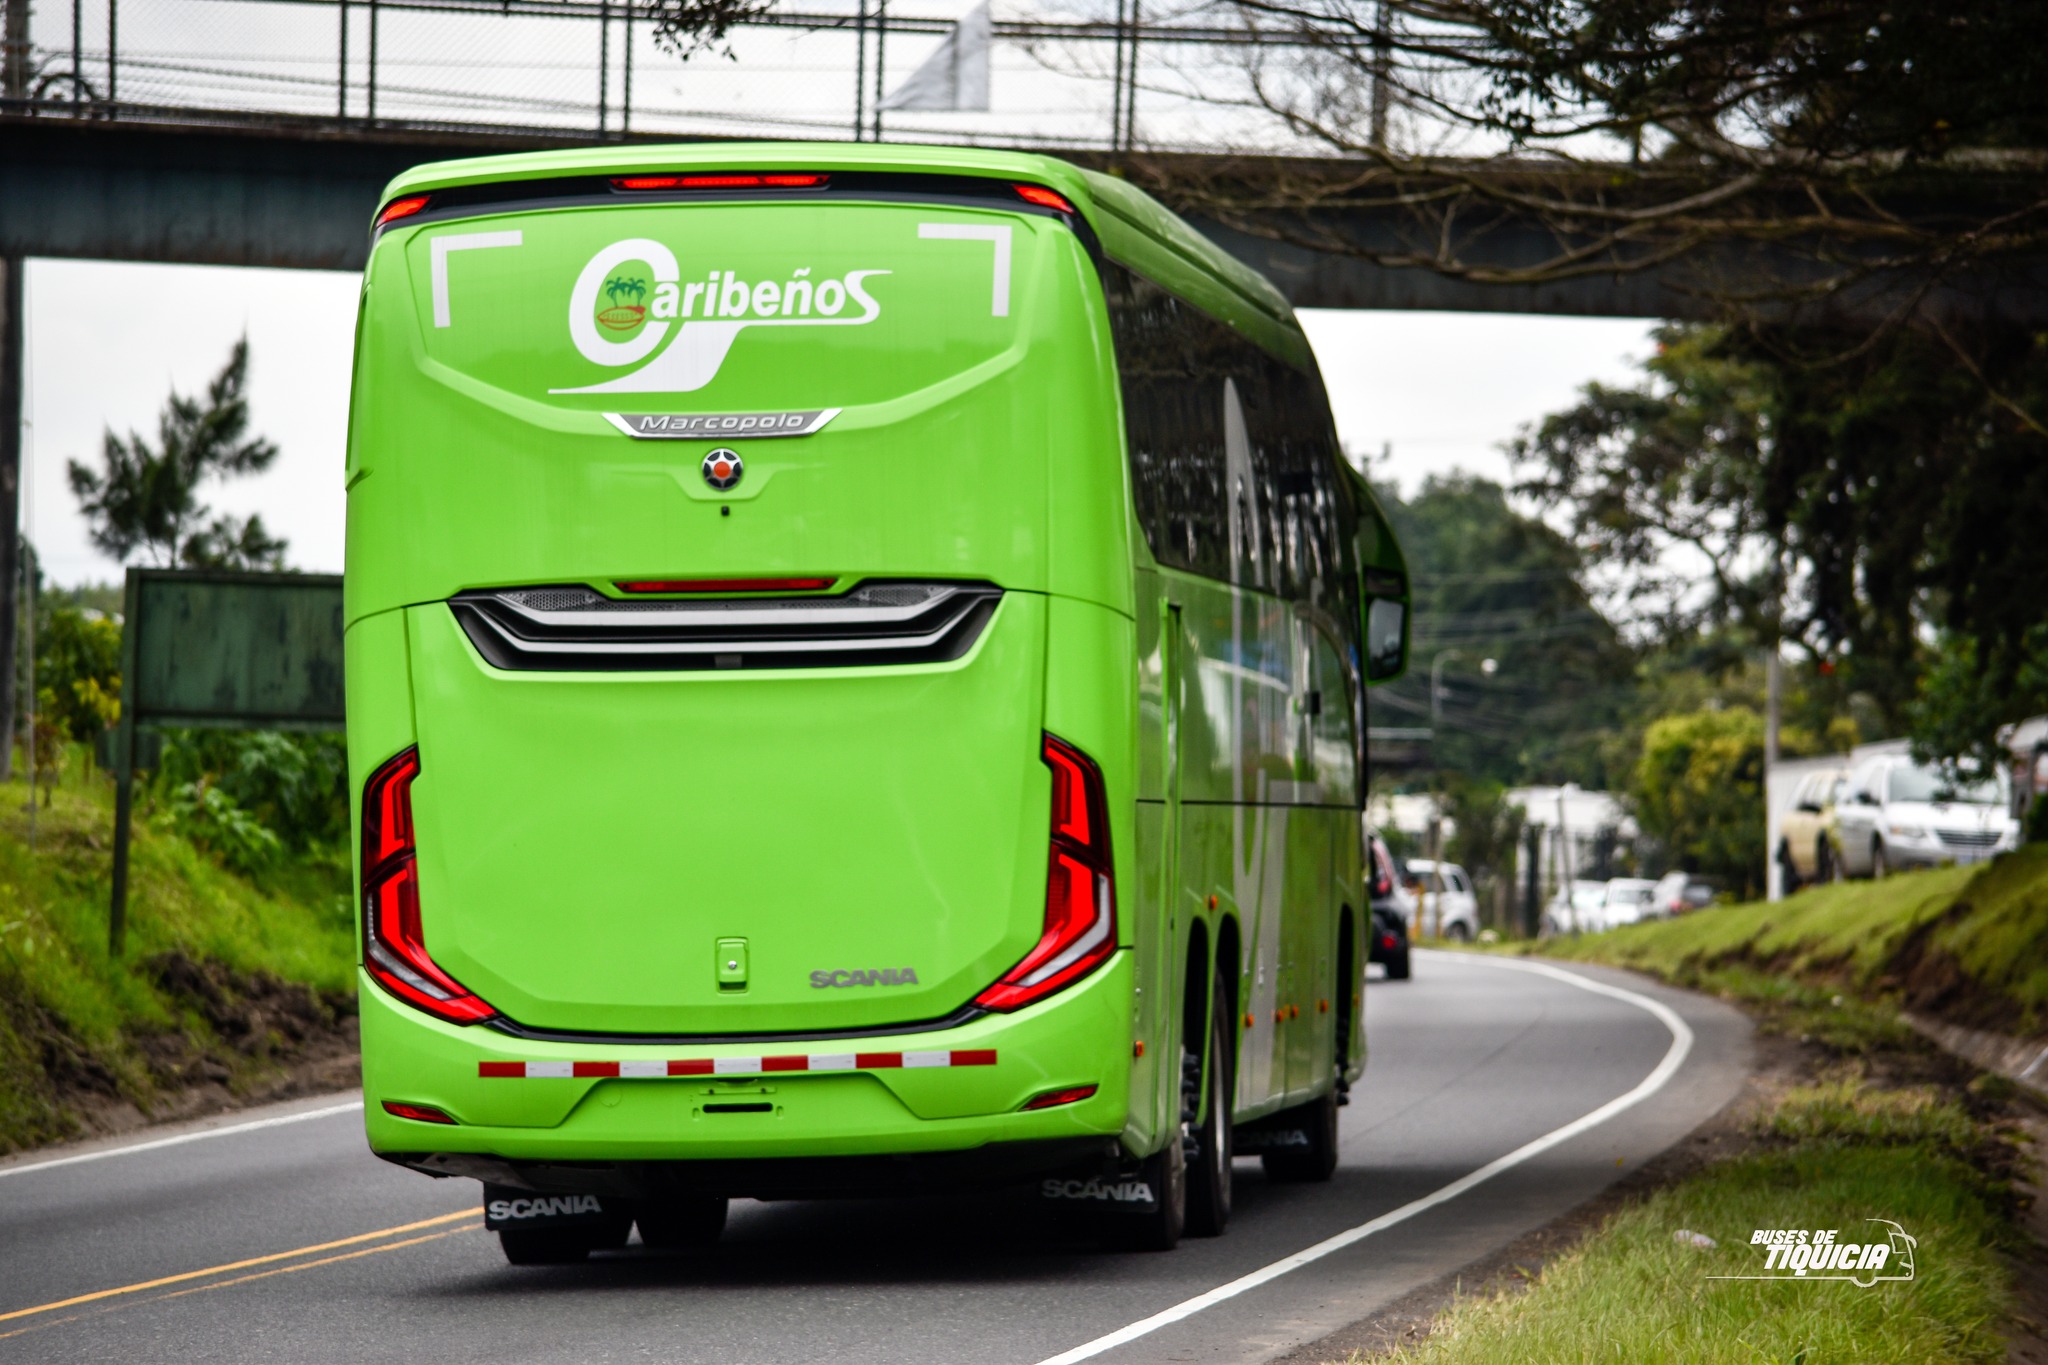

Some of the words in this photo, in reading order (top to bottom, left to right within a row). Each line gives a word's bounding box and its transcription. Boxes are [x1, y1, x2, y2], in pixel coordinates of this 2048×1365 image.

[640, 413, 805, 432] Marcopolo
[809, 967, 919, 989] SCANIA
[1233, 1129, 1309, 1147] CANIA
[1041, 1178, 1155, 1203] SCANIA
[488, 1194, 603, 1221] SCANIA
